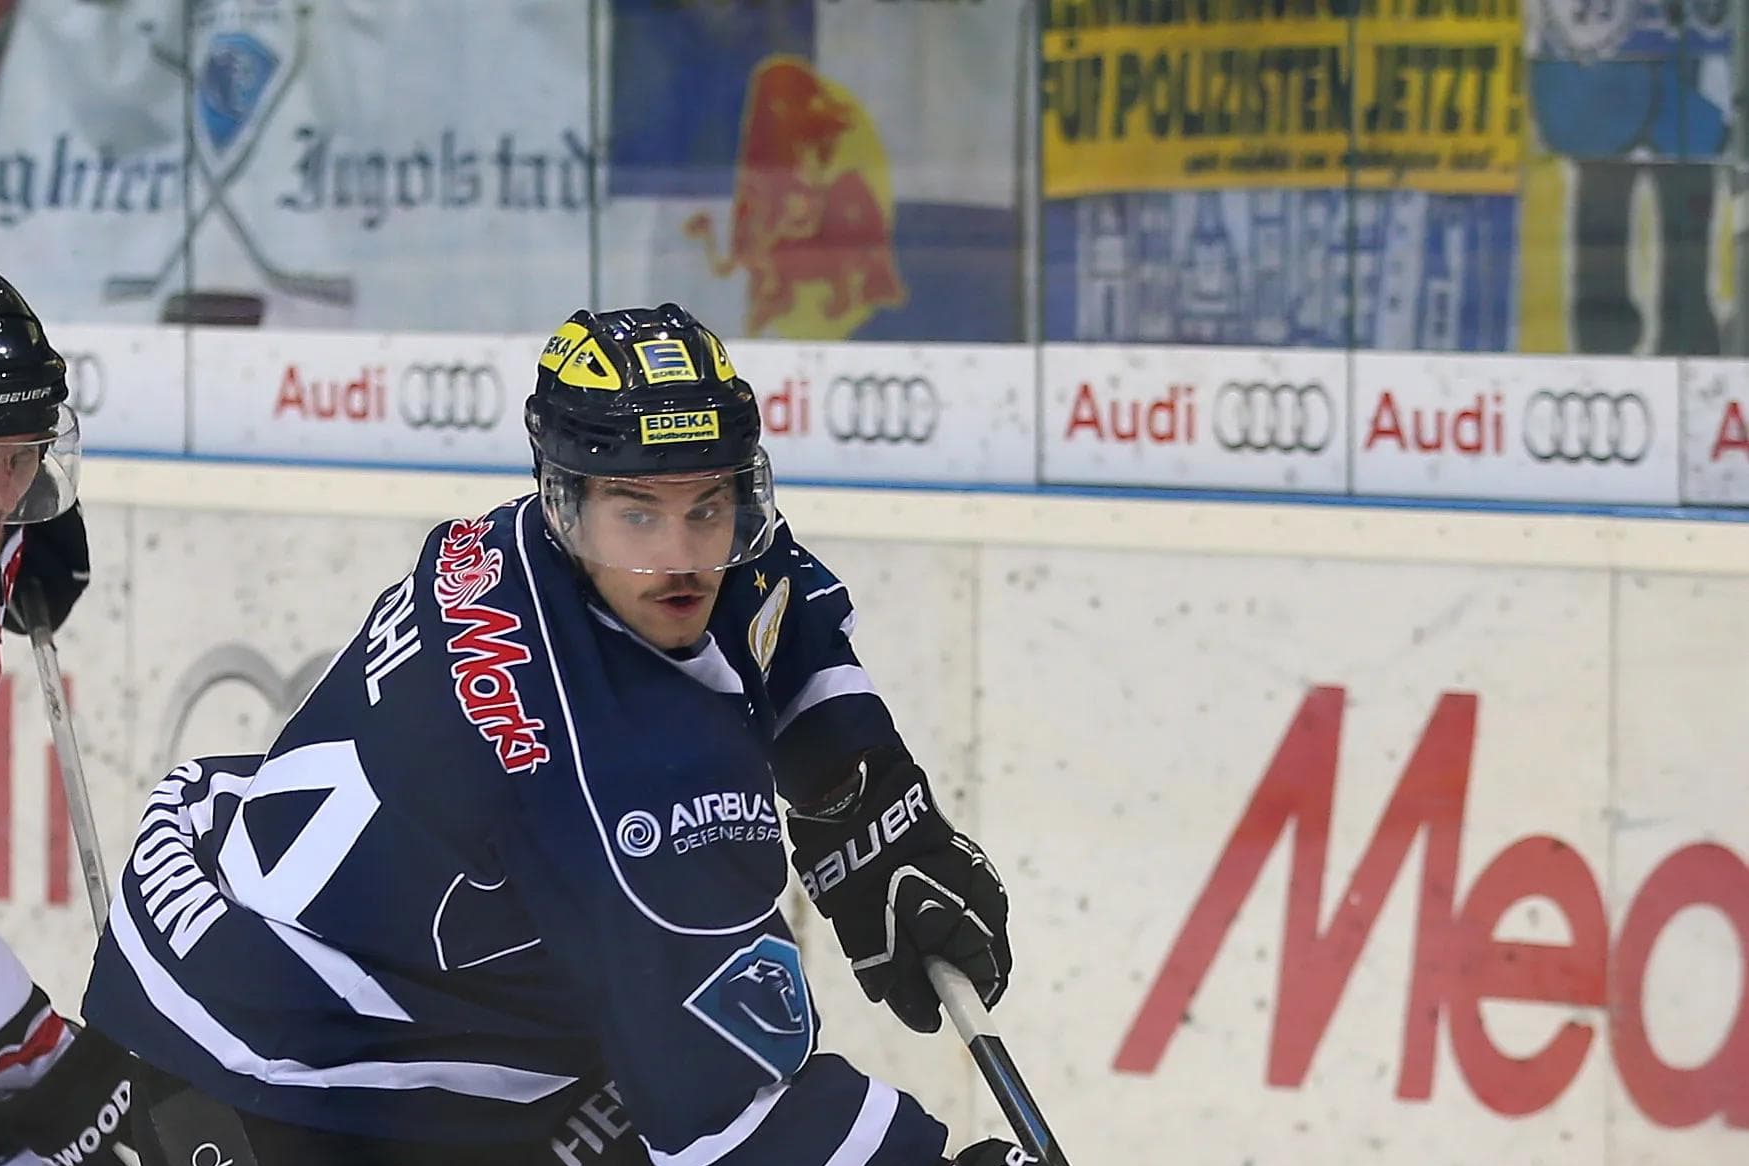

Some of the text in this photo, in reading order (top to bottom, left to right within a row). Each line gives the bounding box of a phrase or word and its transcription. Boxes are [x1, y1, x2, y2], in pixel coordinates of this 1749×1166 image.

[274, 367, 388, 422] Audi
[651, 369, 692, 379] EDEKA
[646, 413, 714, 431] EDEKA
[763, 378, 811, 436] di
[1065, 384, 1196, 444] Audi
[1364, 392, 1505, 454] Audi
[366, 574, 422, 706] OHL
[671, 792, 777, 837] AIRBUS
[801, 782, 929, 901] BAUER
